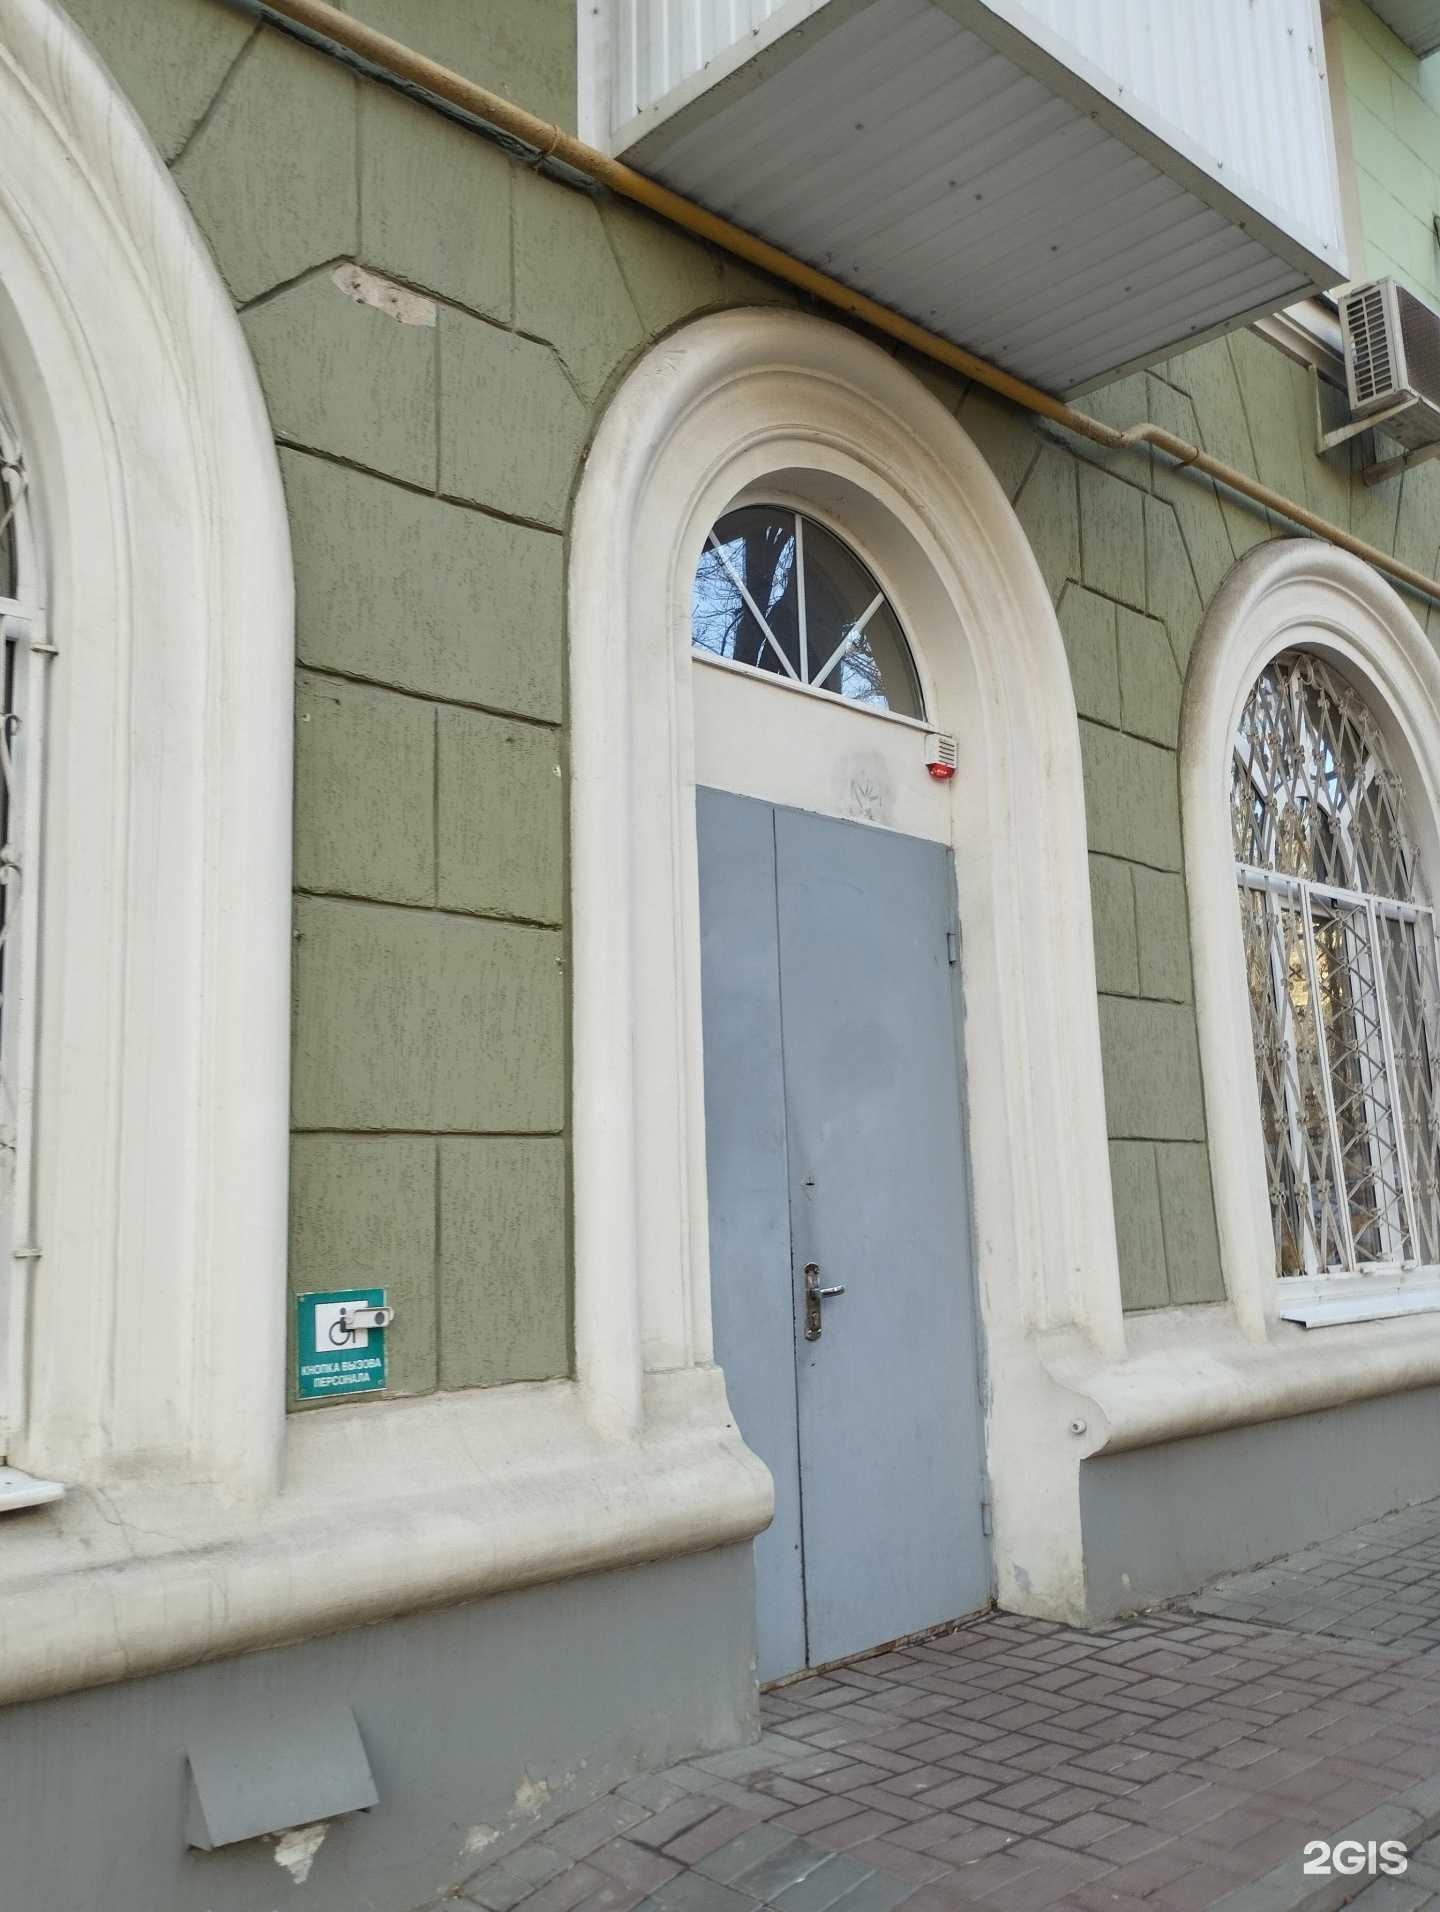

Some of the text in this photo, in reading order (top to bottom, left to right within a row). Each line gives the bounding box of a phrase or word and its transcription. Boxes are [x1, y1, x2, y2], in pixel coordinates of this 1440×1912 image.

[301, 1358, 381, 1375] КНОПКА ВЫЗОВА
[313, 1372, 370, 1387] ПЕРСОНАЛА
